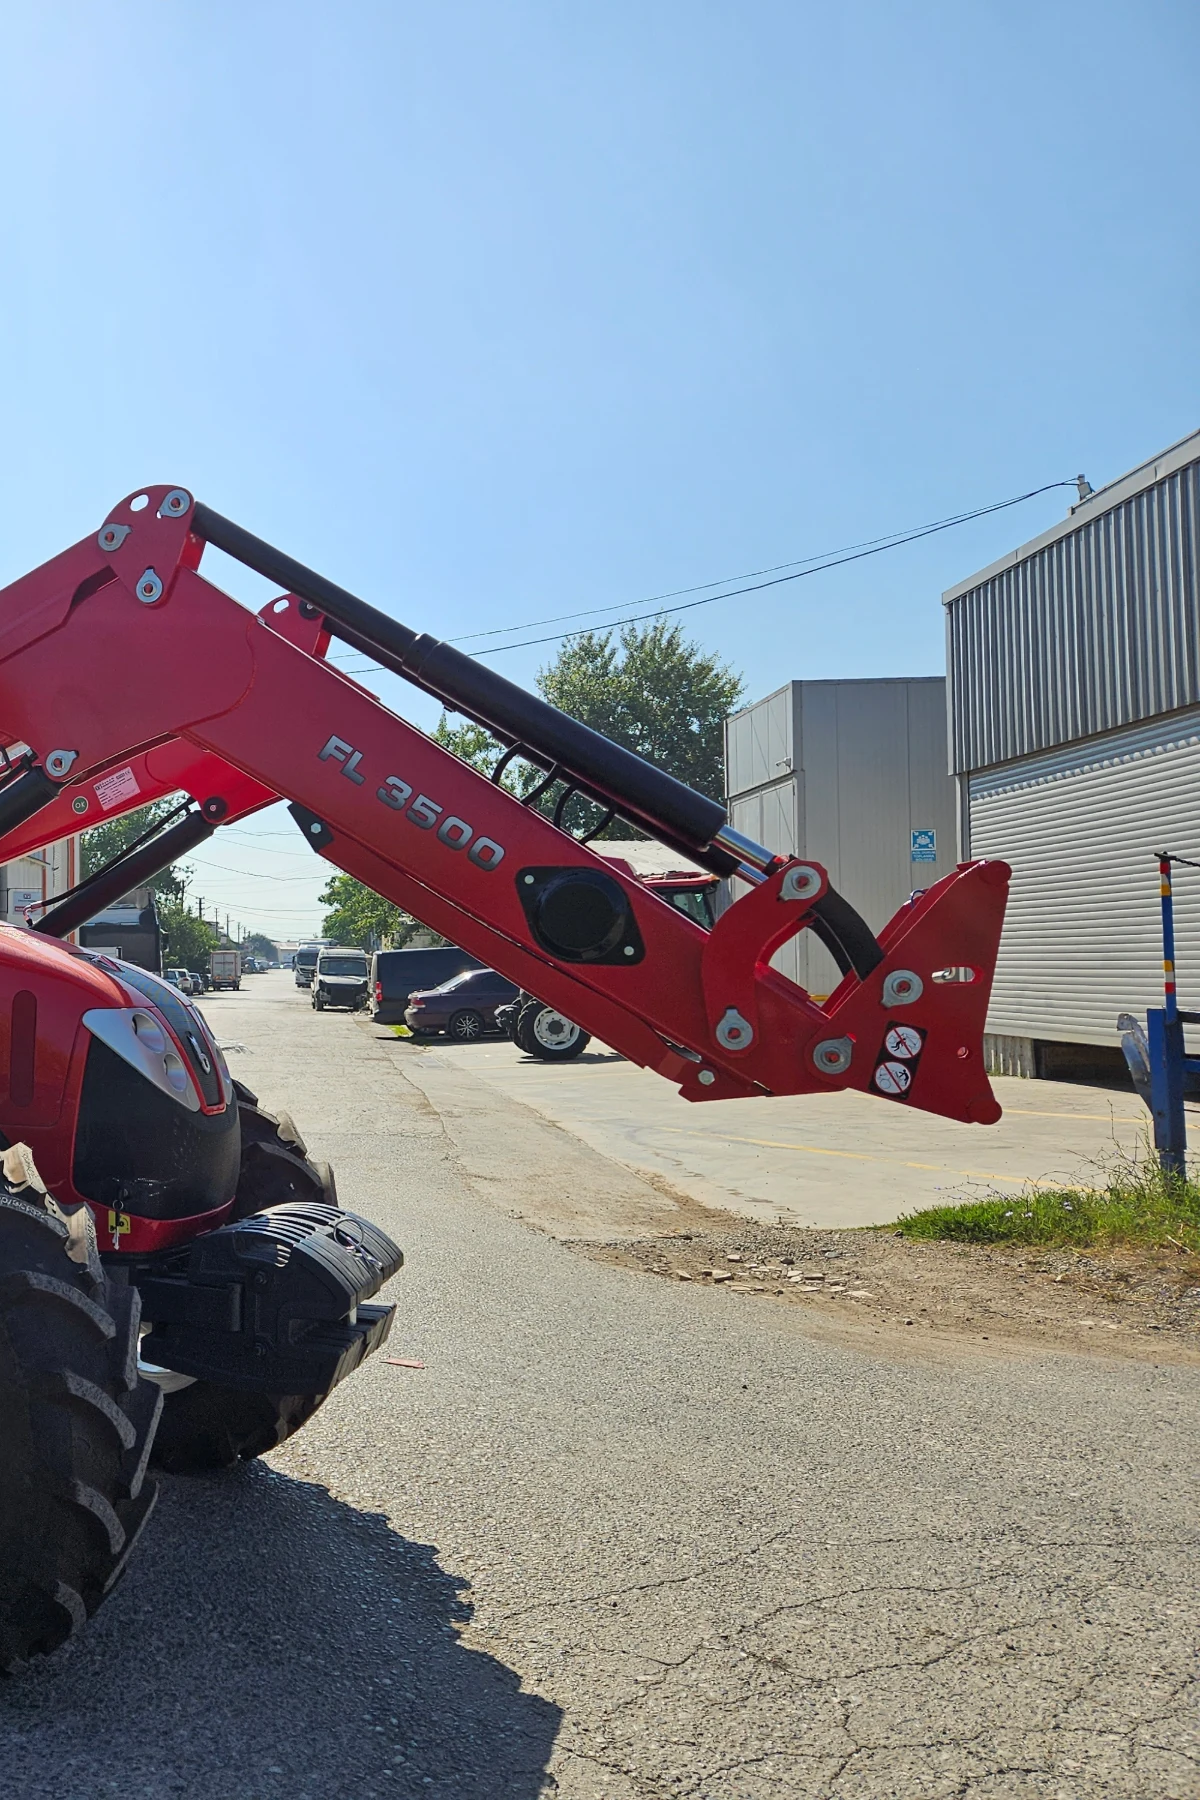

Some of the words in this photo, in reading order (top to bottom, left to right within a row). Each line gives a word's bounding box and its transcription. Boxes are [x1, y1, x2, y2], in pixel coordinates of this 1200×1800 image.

[74, 801, 86, 809] OK
[317, 734, 366, 787] FL
[376, 775, 506, 872] 3500
